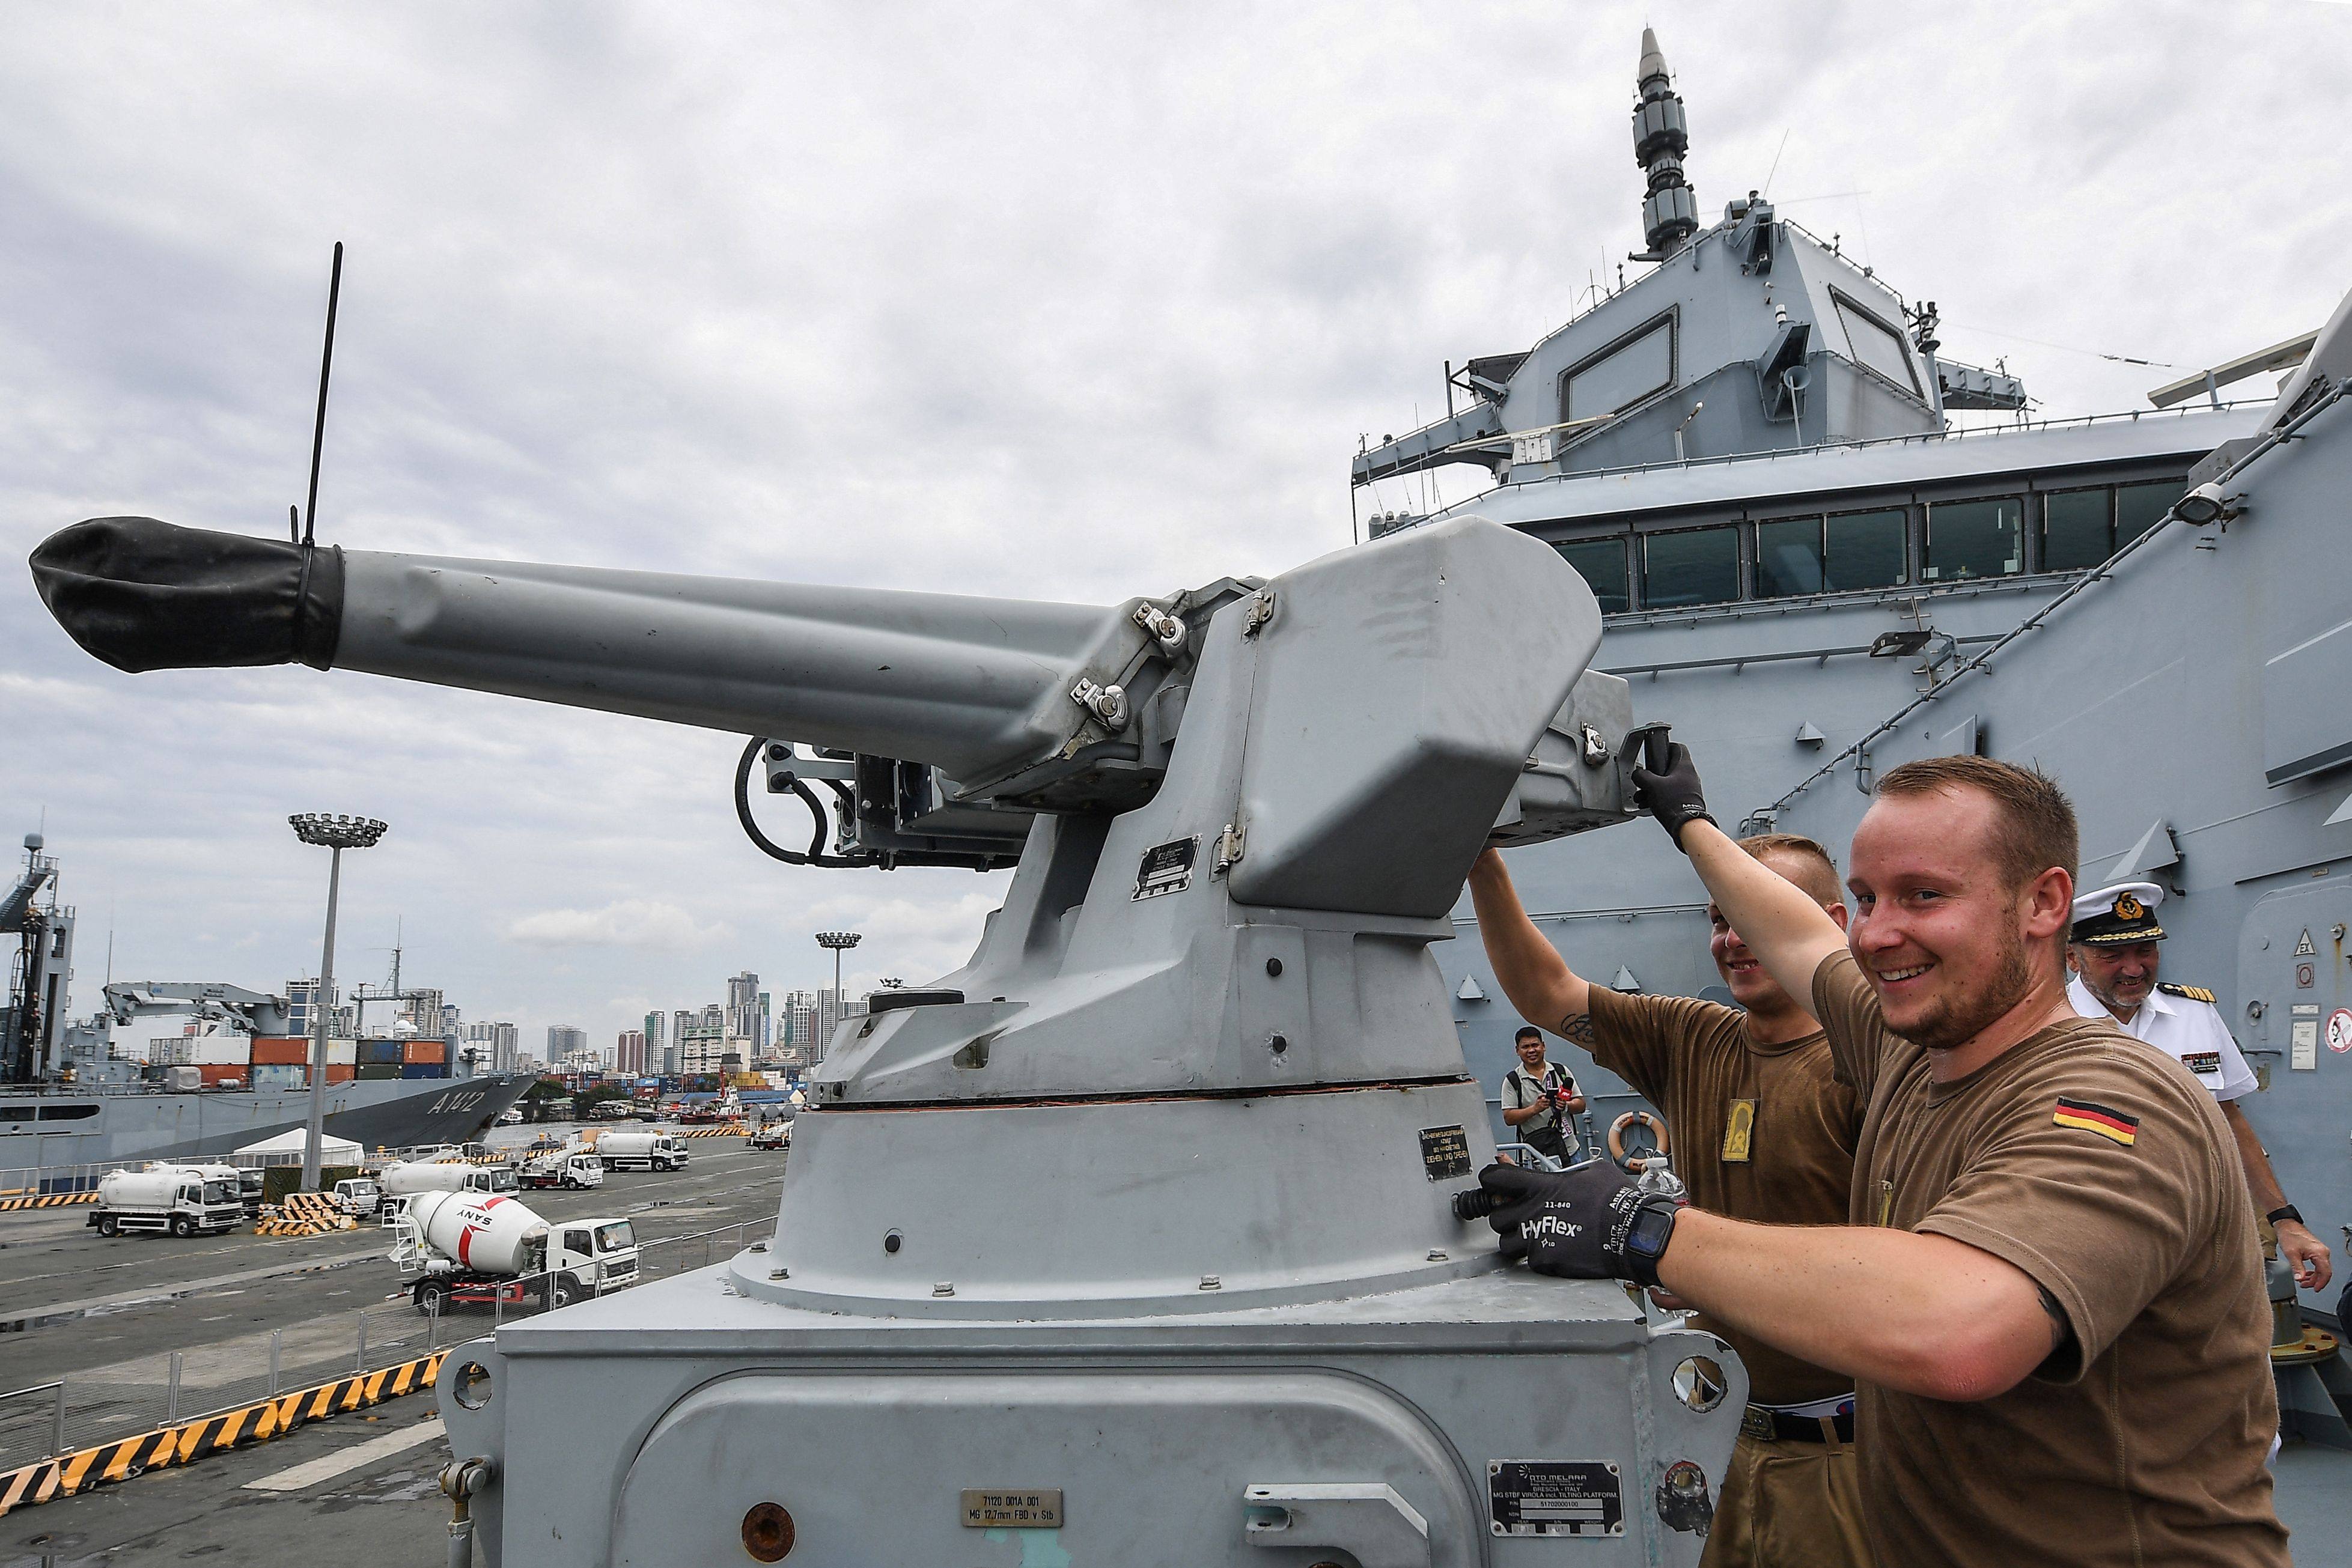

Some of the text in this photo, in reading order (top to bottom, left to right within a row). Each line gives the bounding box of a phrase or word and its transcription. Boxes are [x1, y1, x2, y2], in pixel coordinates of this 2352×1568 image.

[2300, 943, 2309, 953] EX
[427, 1091, 486, 1114] A 1412
[1609, 1186, 1631, 1209] Ansell
[456, 1209, 493, 1226] SANY
[1625, 1211, 1636, 1227] Made
[983, 1496, 1039, 1506] 71120 001A 001
[969, 1509, 981, 1519] MG
[1014, 1509, 1029, 1519] FBD
